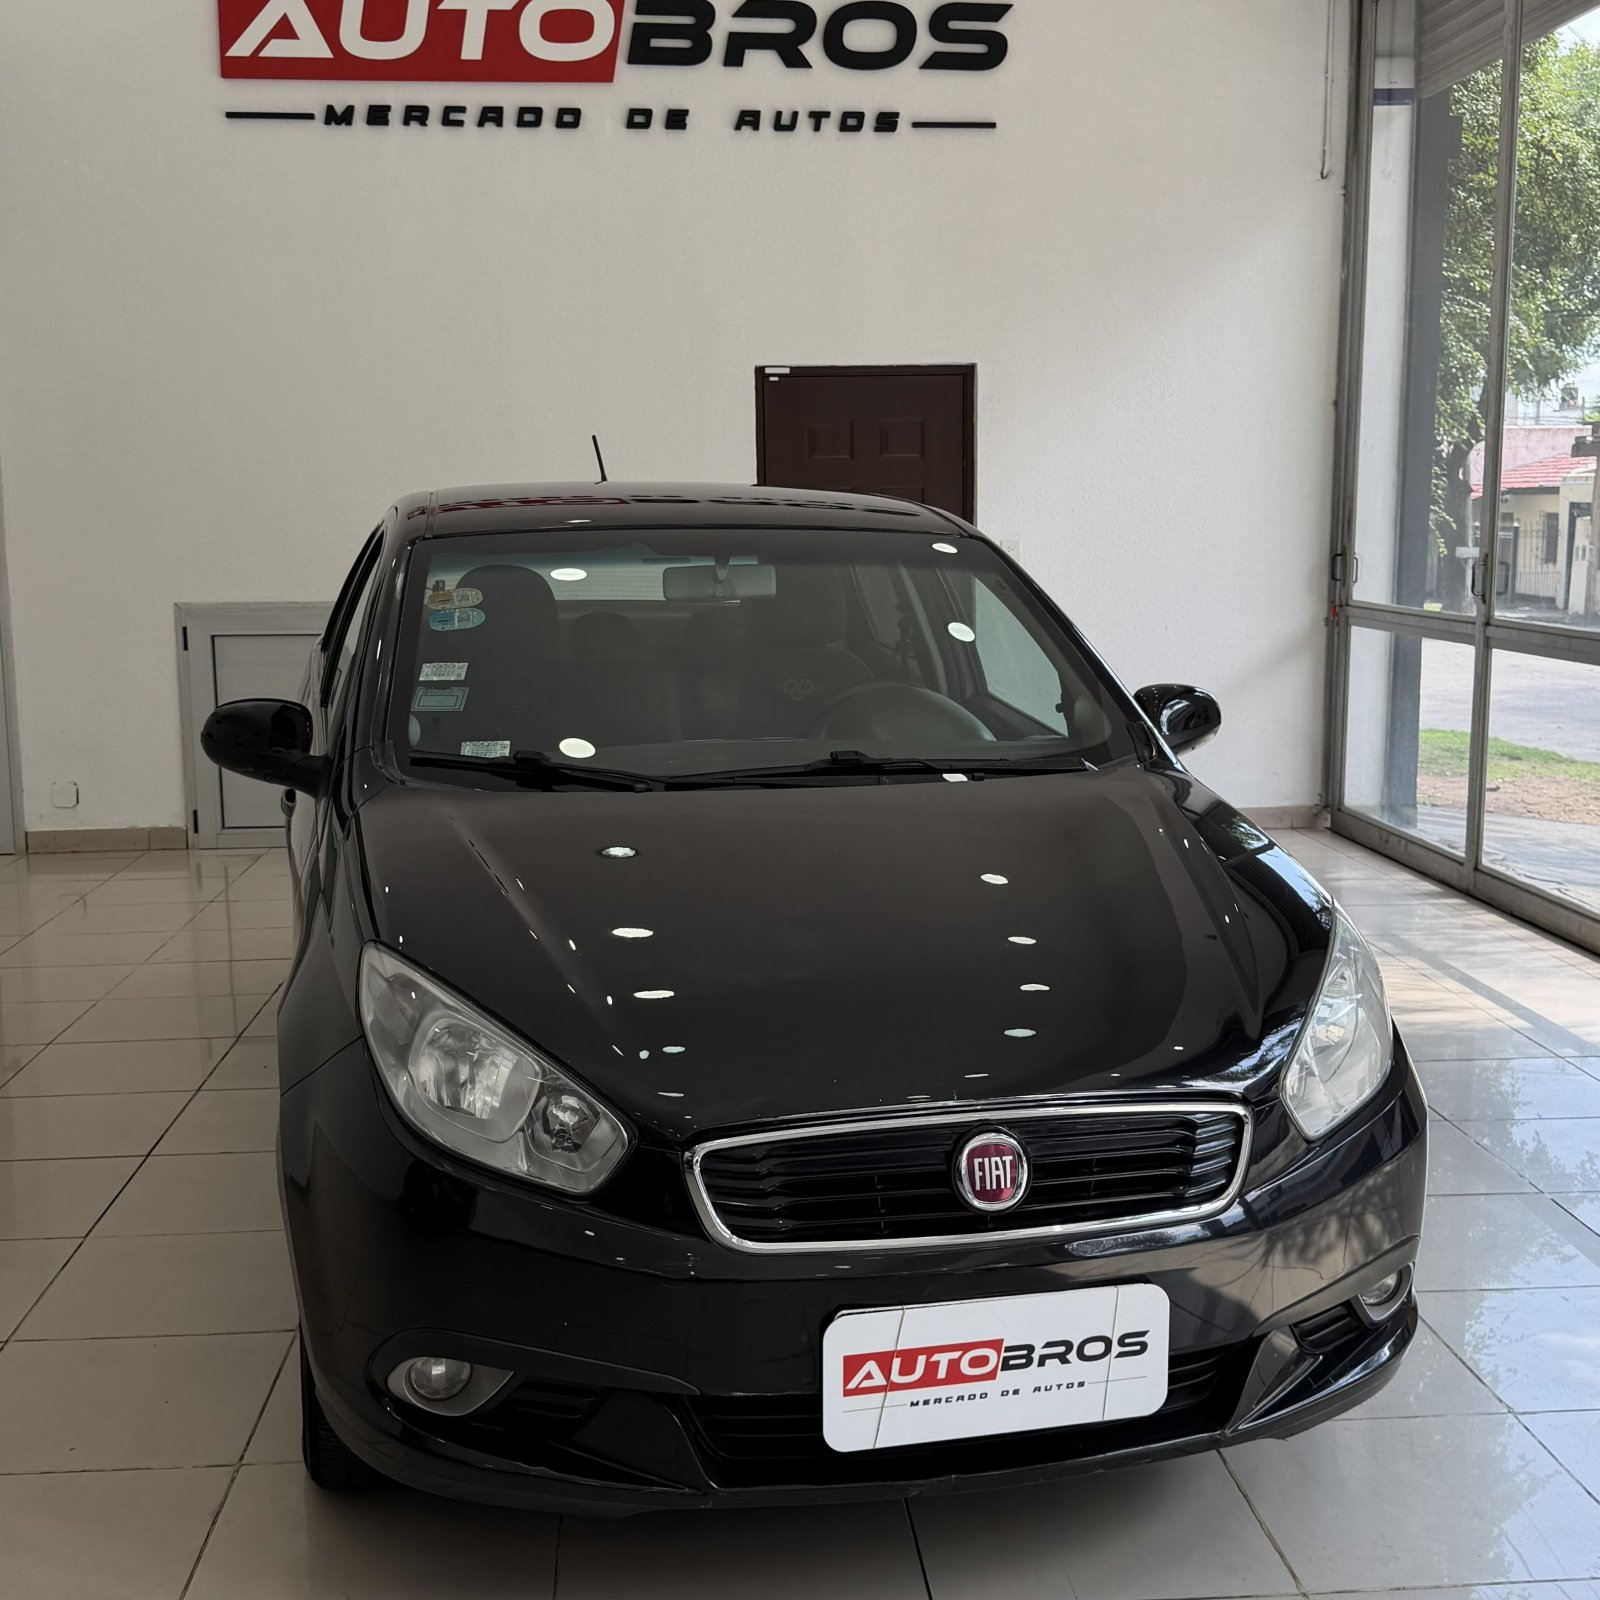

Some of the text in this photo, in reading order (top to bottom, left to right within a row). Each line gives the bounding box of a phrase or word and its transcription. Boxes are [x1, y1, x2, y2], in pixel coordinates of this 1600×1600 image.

[323, 104, 900, 133] MERCADO DE AUTOS
[973, 1155, 1013, 1191] FIAT
[845, 1329, 1150, 1390] AUTOBROS
[909, 1380, 1086, 1408] MERCADO DE AUTOS
